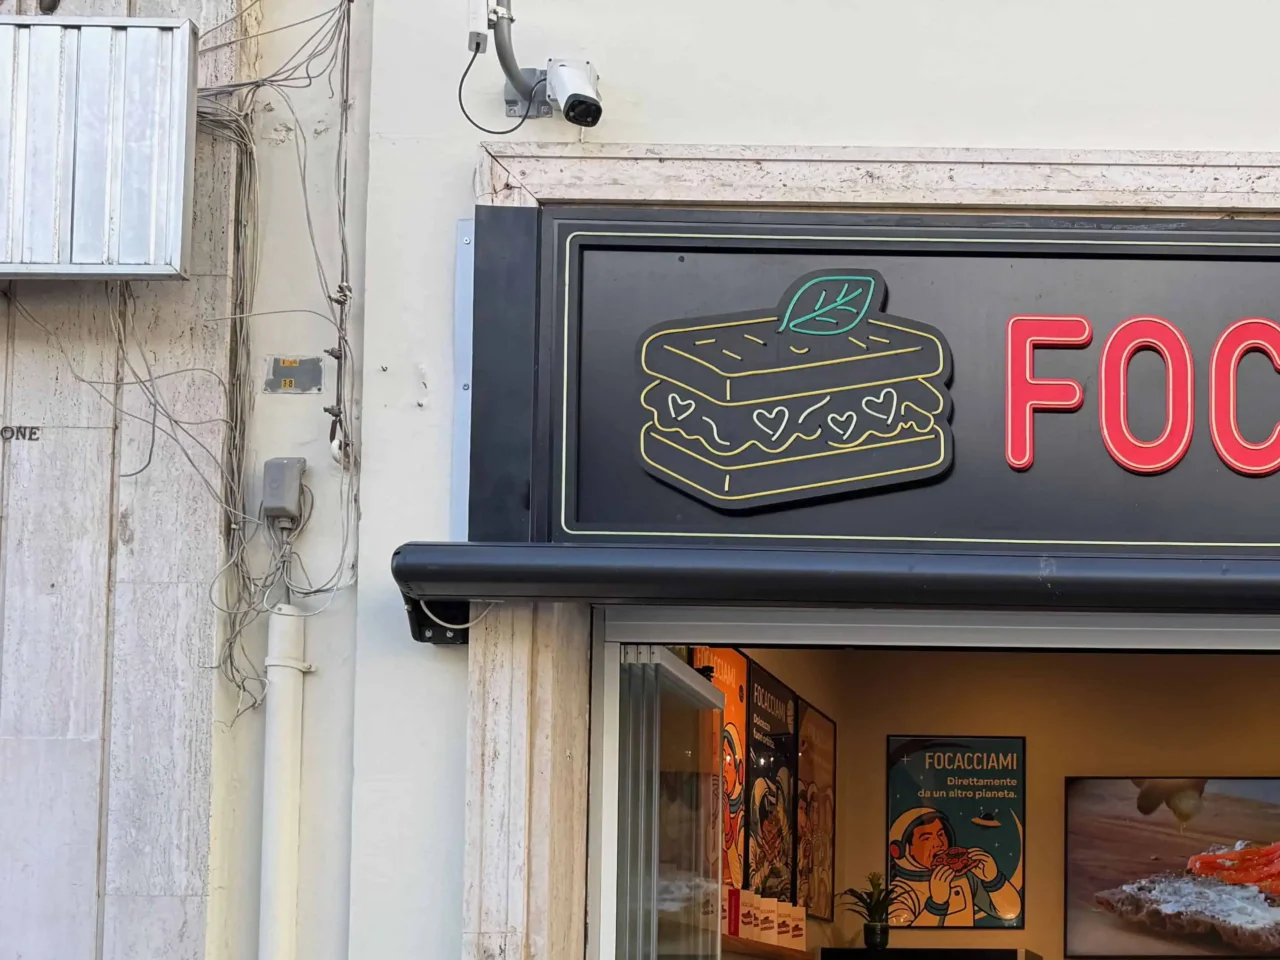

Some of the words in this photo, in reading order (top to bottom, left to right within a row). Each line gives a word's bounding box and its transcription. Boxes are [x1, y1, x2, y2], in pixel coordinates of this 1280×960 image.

[0, 426, 40, 441] ONE
[925, 752, 1017, 770] FOCACCIAMI
[947, 776, 1017, 786] Direttamente
[918, 789, 930, 798] da
[933, 790, 946, 798] un
[948, 789, 973, 798] altro
[975, 789, 1017, 799] pianeta.
